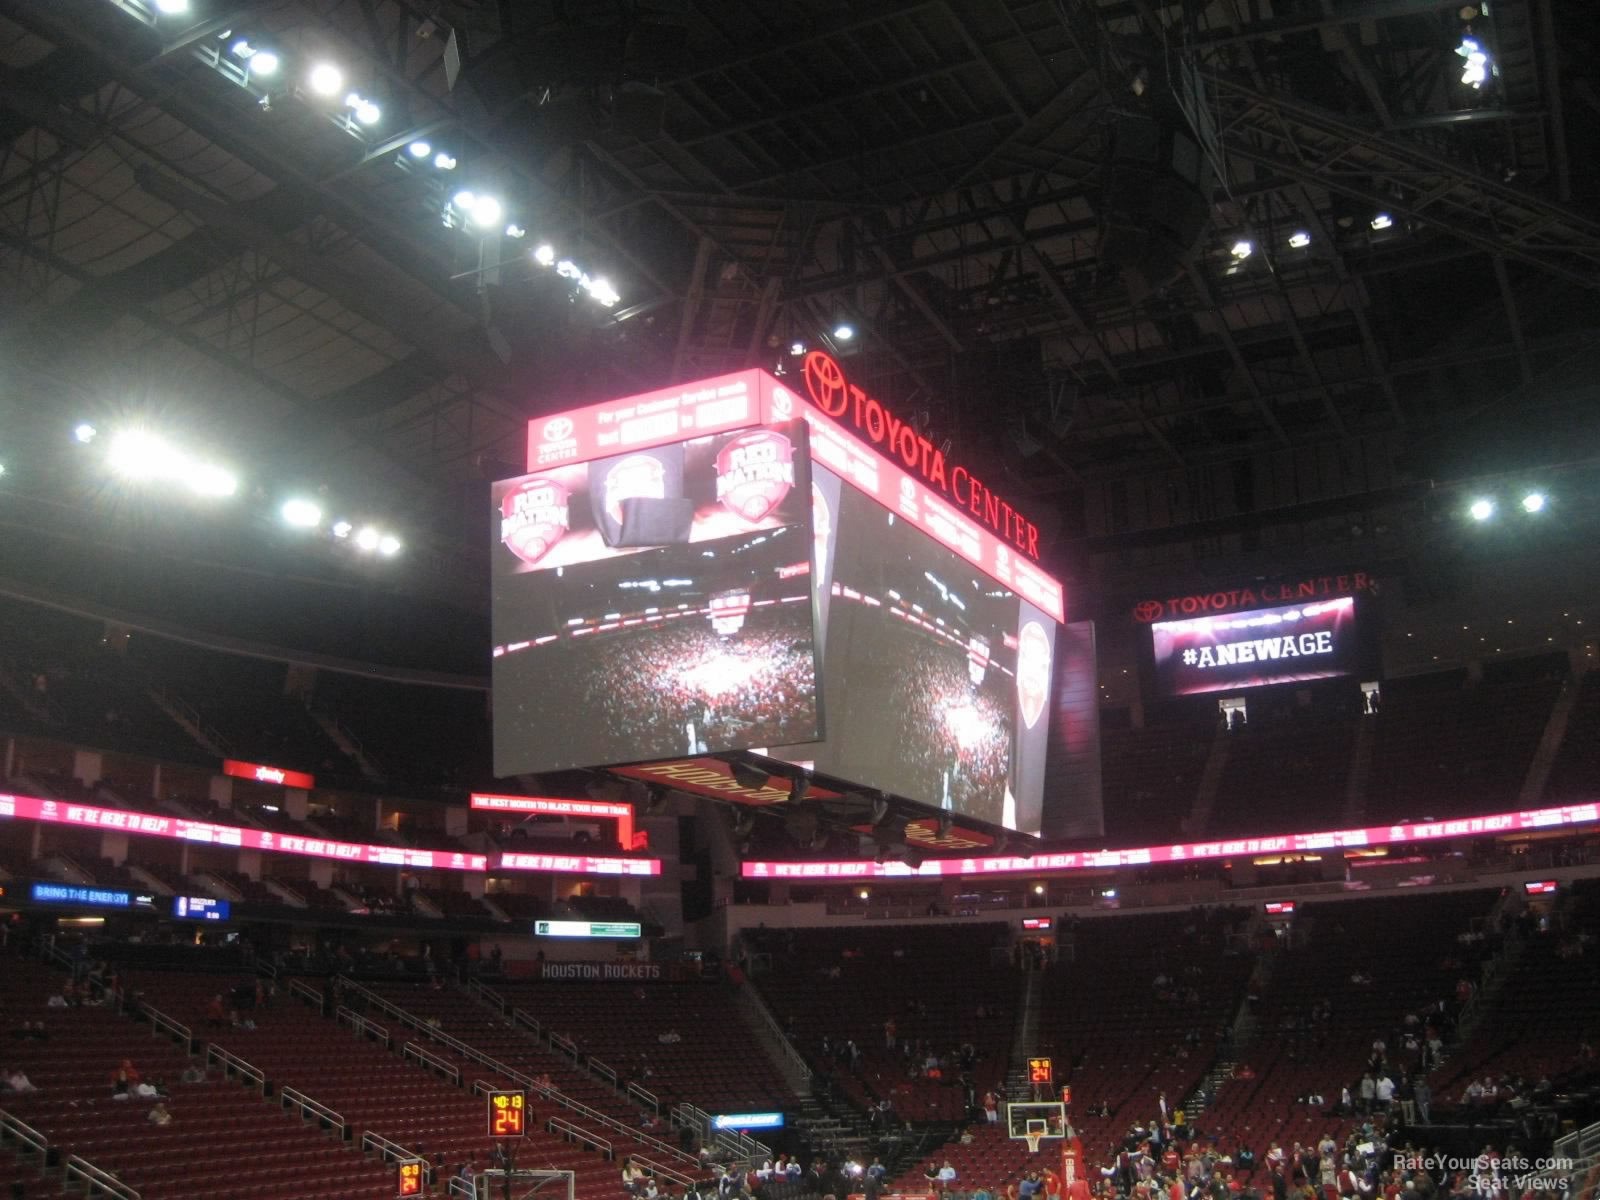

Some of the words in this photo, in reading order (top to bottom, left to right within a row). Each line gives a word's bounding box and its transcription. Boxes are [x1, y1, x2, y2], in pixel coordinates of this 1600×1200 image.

[730, 442, 776, 470] RED
[717, 462, 794, 497] NATION
[849, 384, 948, 491] TOYOTA
[952, 466, 1040, 560] CENTER
[514, 487, 553, 516] RED
[501, 505, 568, 539] NATION
[1168, 588, 1257, 616] TOYOTA
[1261, 572, 1369, 602] CENTER
[1183, 631, 1333, 668] #ANEWAGE
[67, 806, 100, 823] WE'RE
[100, 811, 126, 826] HERE
[128, 815, 140, 829] TO
[141, 817, 168, 832] HELP!
[1471, 820, 1483, 832] TO
[326, 843, 336, 855] TO
[1248, 840, 1260, 852] TO
[541, 856, 552, 868] TO
[36, 885, 67, 898] BRING
[69, 889, 87, 900] THE
[89, 891, 129, 904] ENERGY!
[542, 963, 600, 979] HOUSTON
[604, 963, 661, 979] ROCKETS
[1032, 1068, 1048, 1081] 24
[495, 1110, 519, 1133] 24
[403, 1177, 416, 1191] 24
